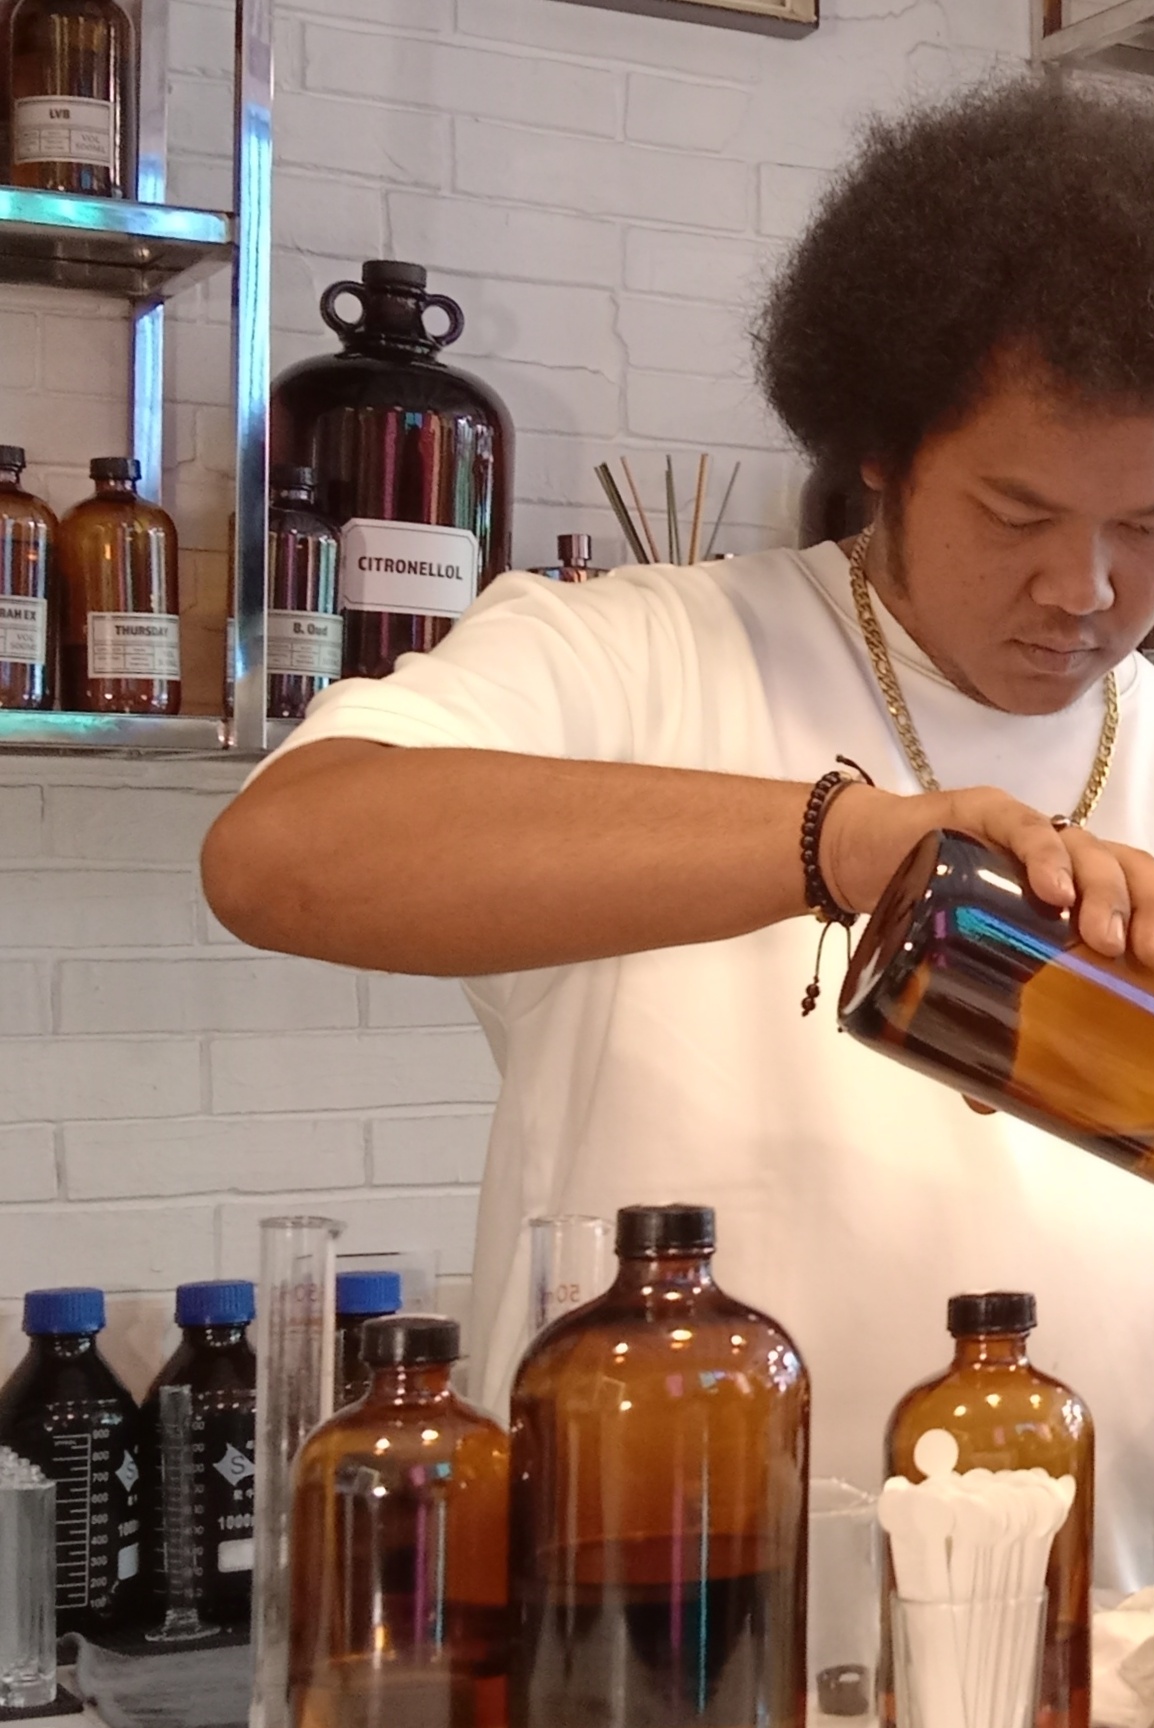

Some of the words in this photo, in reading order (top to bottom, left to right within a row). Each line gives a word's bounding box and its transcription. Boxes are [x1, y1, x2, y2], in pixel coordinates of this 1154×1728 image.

[358, 556, 464, 581] CITRONELLOL
[115, 625, 169, 636] THURSDAY
[92, 1428, 110, 1440] 900
[92, 1450, 110, 1462] 800
[231, 1456, 245, 1475] S
[92, 1471, 110, 1482] 700
[91, 1492, 109, 1504] 600
[91, 1513, 109, 1525] 500
[90, 1534, 108, 1545] 400
[90, 1555, 108, 1567] 300
[89, 1576, 107, 1588] 200
